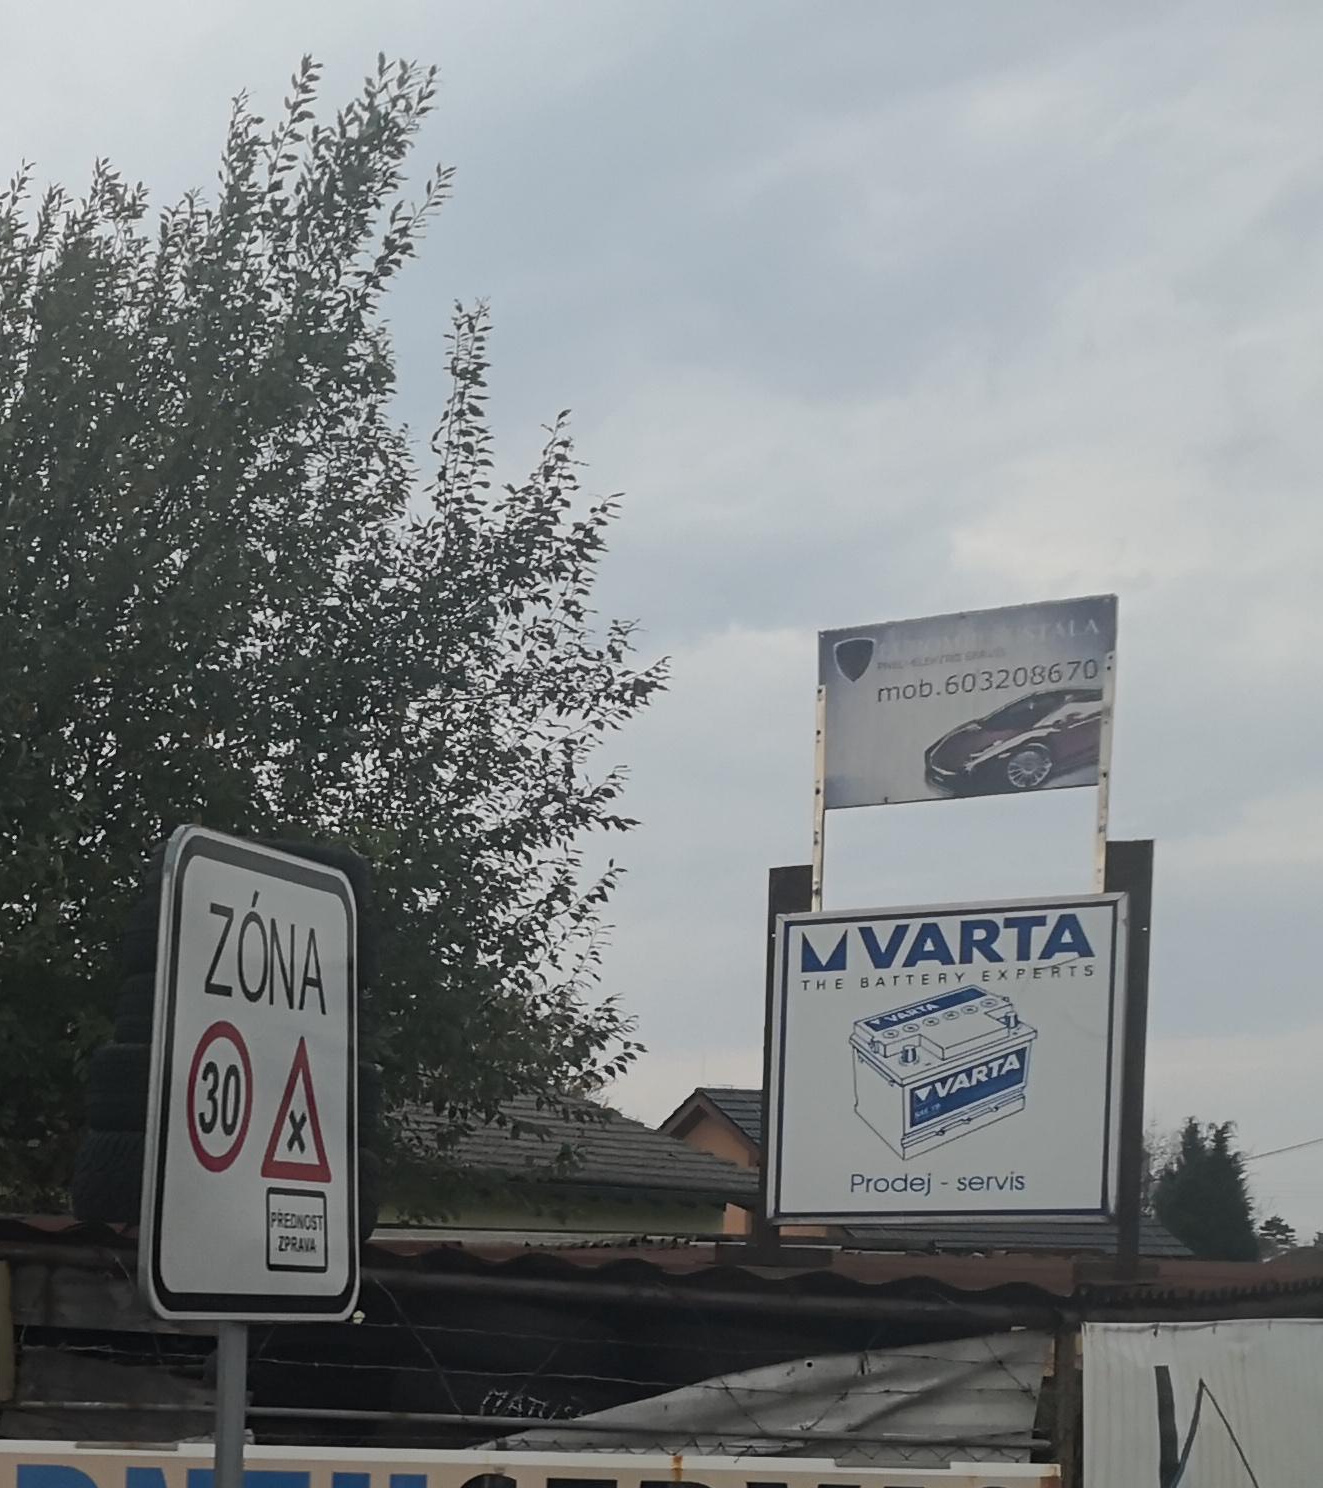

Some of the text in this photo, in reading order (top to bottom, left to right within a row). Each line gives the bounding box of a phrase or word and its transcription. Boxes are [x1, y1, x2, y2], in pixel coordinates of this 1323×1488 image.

[876, 658, 1100, 704] mob.603208670
[203, 890, 327, 1016] ZÓNA
[858, 913, 1096, 969] VARTA
[801, 963, 1095, 992] THE BATTERY EXPERTS
[883, 1002, 940, 1023] VARTA
[933, 1053, 1021, 1099] VARTA
[197, 1061, 242, 1137] 30
[849, 1172, 933, 1197] Prodej
[955, 1174, 1026, 1192] servis
[270, 1209, 323, 1231] PŘEDNOST
[277, 1235, 318, 1254] ZPRAVA
